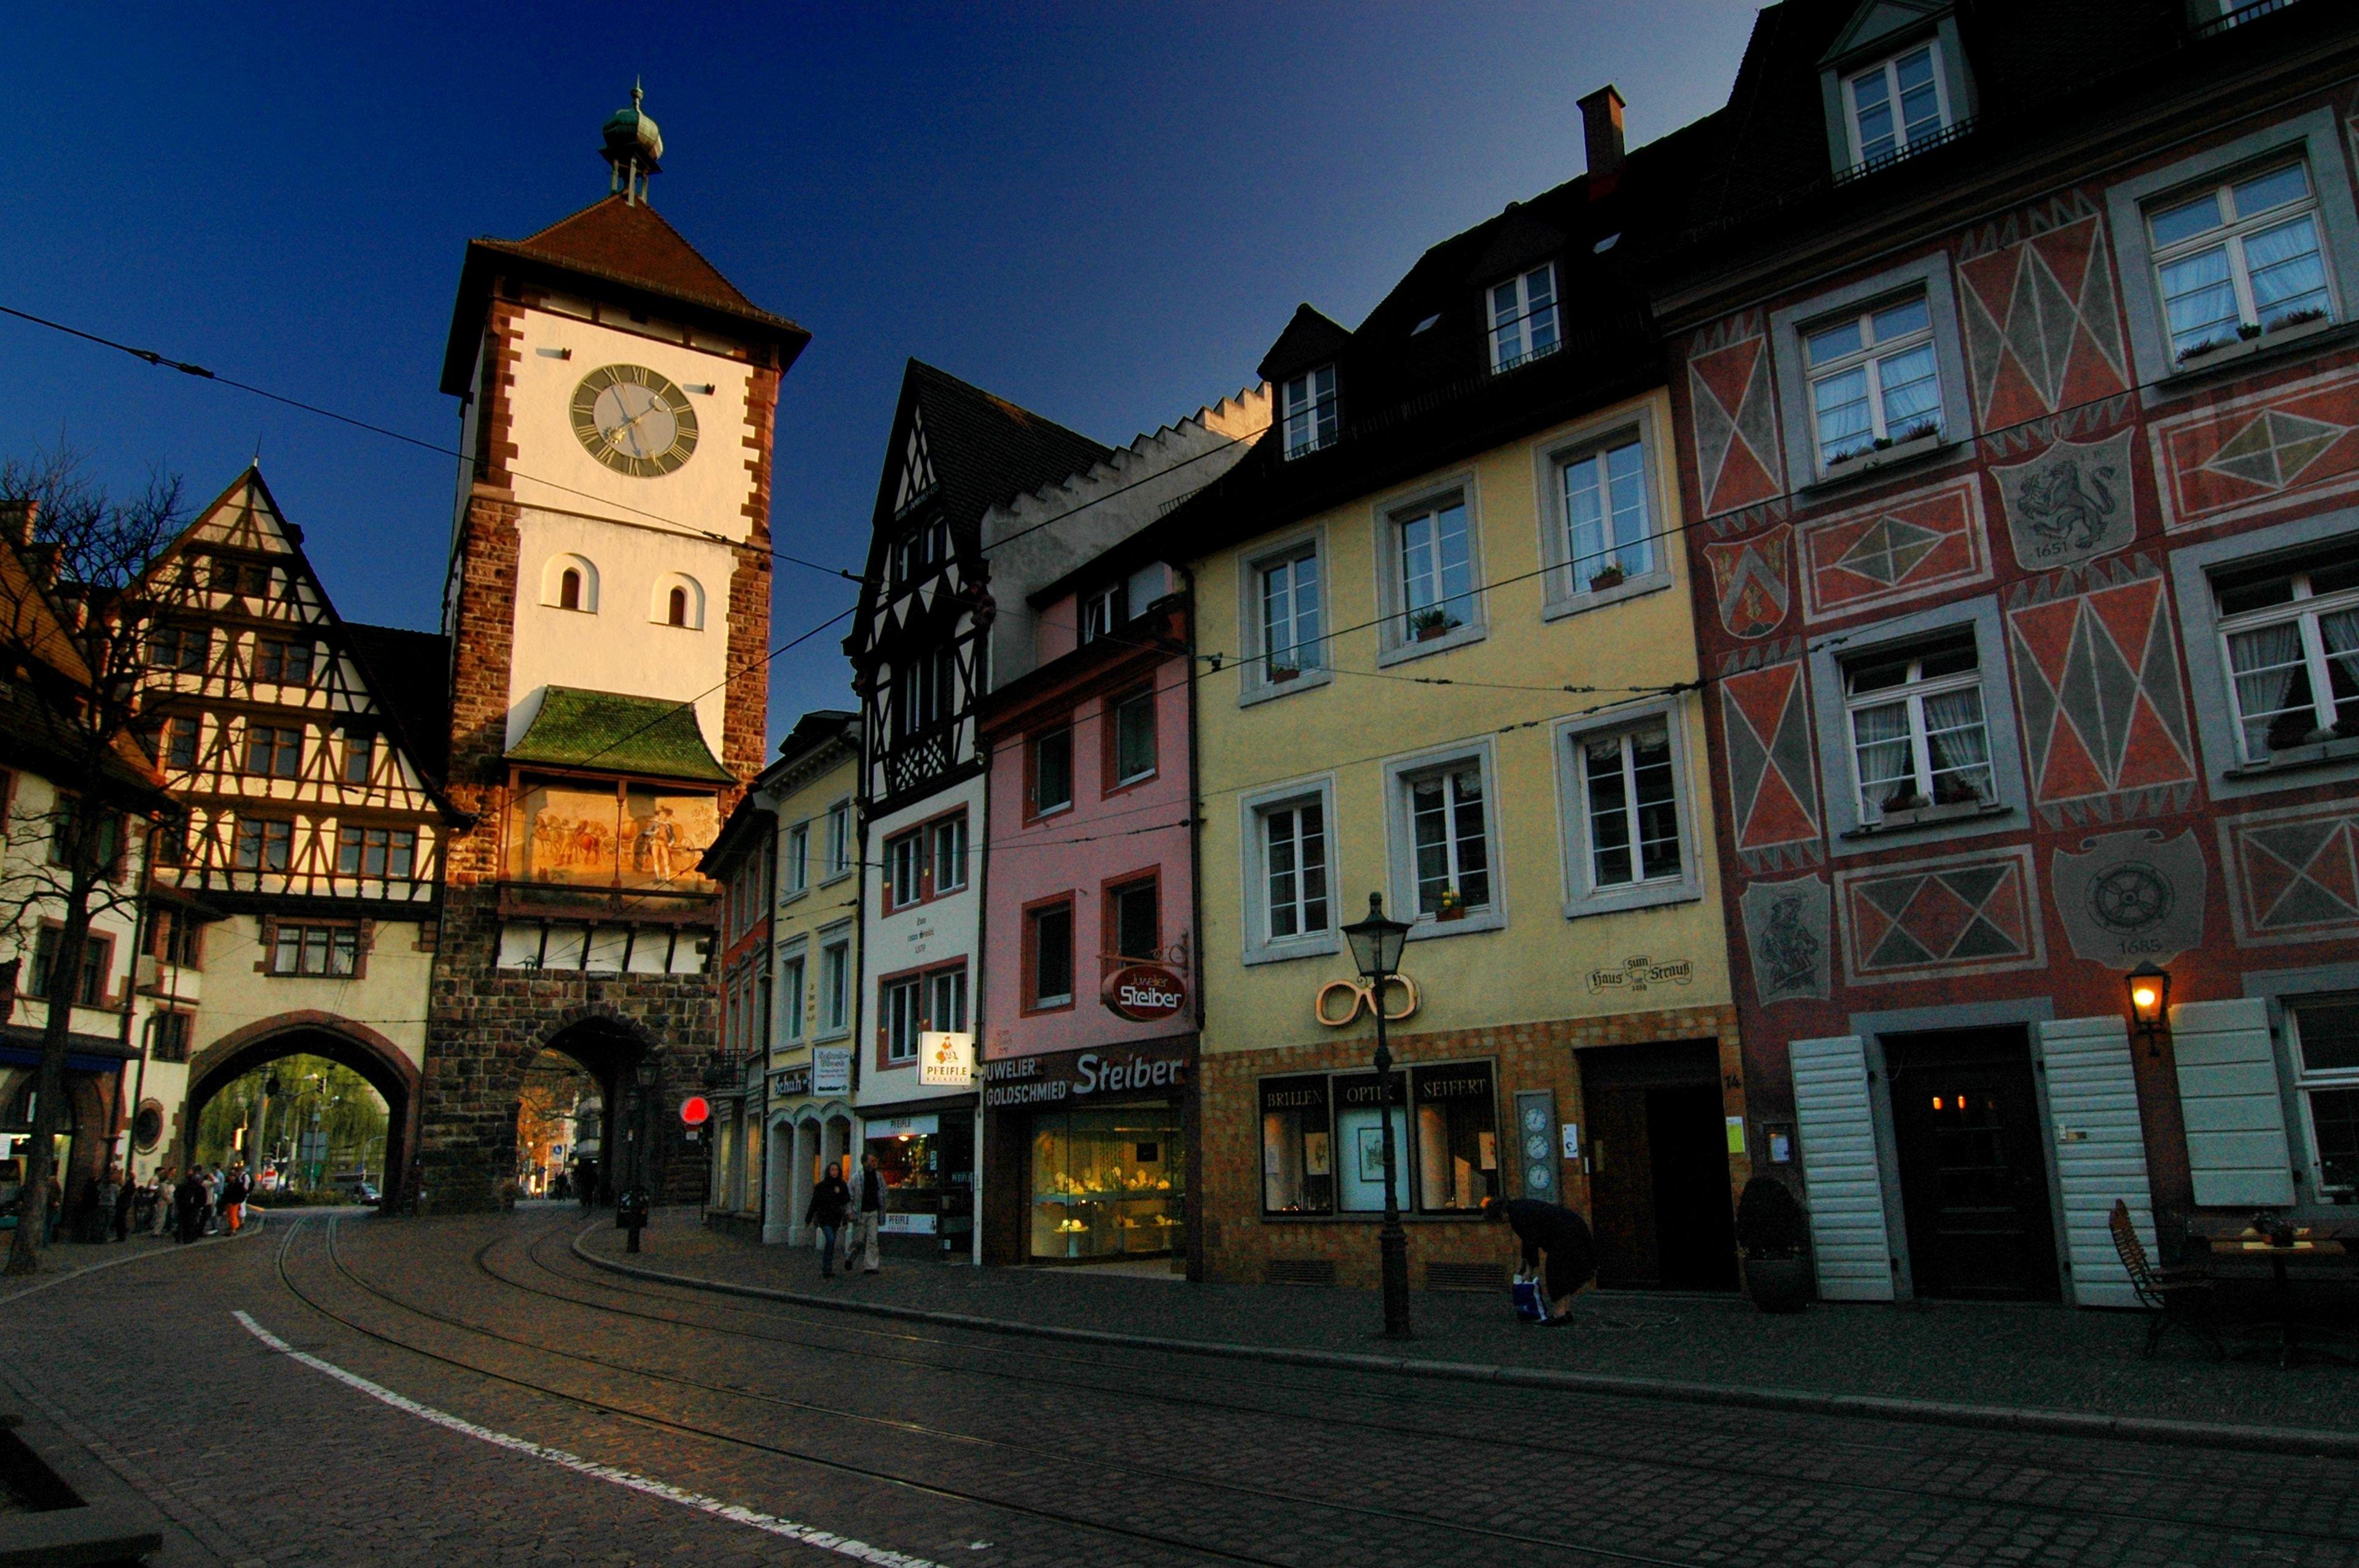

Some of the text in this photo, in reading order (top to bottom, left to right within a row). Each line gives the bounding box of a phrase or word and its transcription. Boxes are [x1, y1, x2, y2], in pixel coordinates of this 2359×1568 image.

[632, 365, 648, 386] XII
[2036, 542, 2068, 558] 1651
[2116, 939, 2162, 954] 1685
[1592, 969, 1624, 986] Haus
[1650, 962, 1691, 980] Strauß
[1119, 985, 1183, 1008] Steiber
[980, 1057, 1036, 1083] JUWELIER
[1071, 1053, 1184, 1094] Steiber
[986, 1080, 1067, 1107] GOLDSCHMIED
[1267, 1089, 1323, 1107] BRILLEN
[1423, 1077, 1487, 1098] SEIFERT
